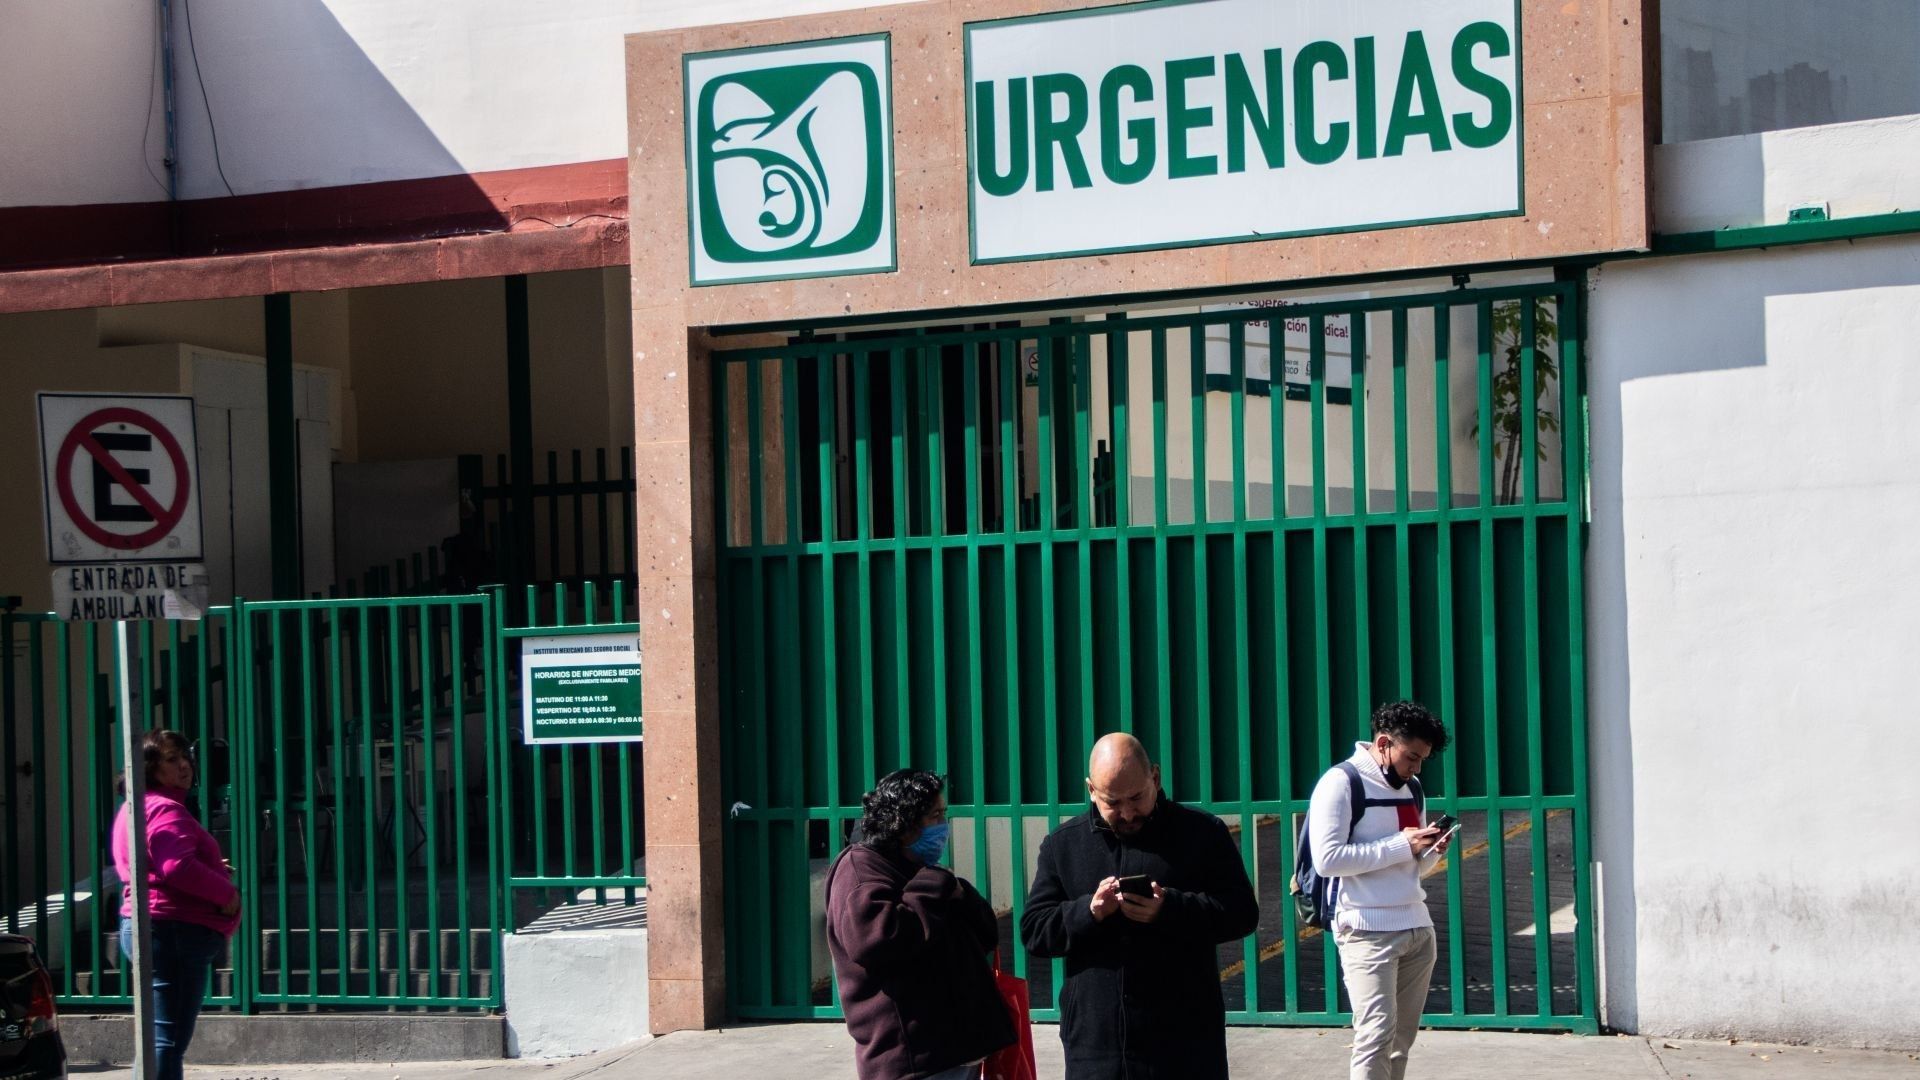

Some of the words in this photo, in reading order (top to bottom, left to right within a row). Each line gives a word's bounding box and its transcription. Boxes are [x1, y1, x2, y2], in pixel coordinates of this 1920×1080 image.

[975, 21, 1512, 197] URGENCIAS
[71, 566, 157, 591] ENTRADA
[166, 565, 188, 587] DE
[535, 671, 570, 679] HORARIOS
